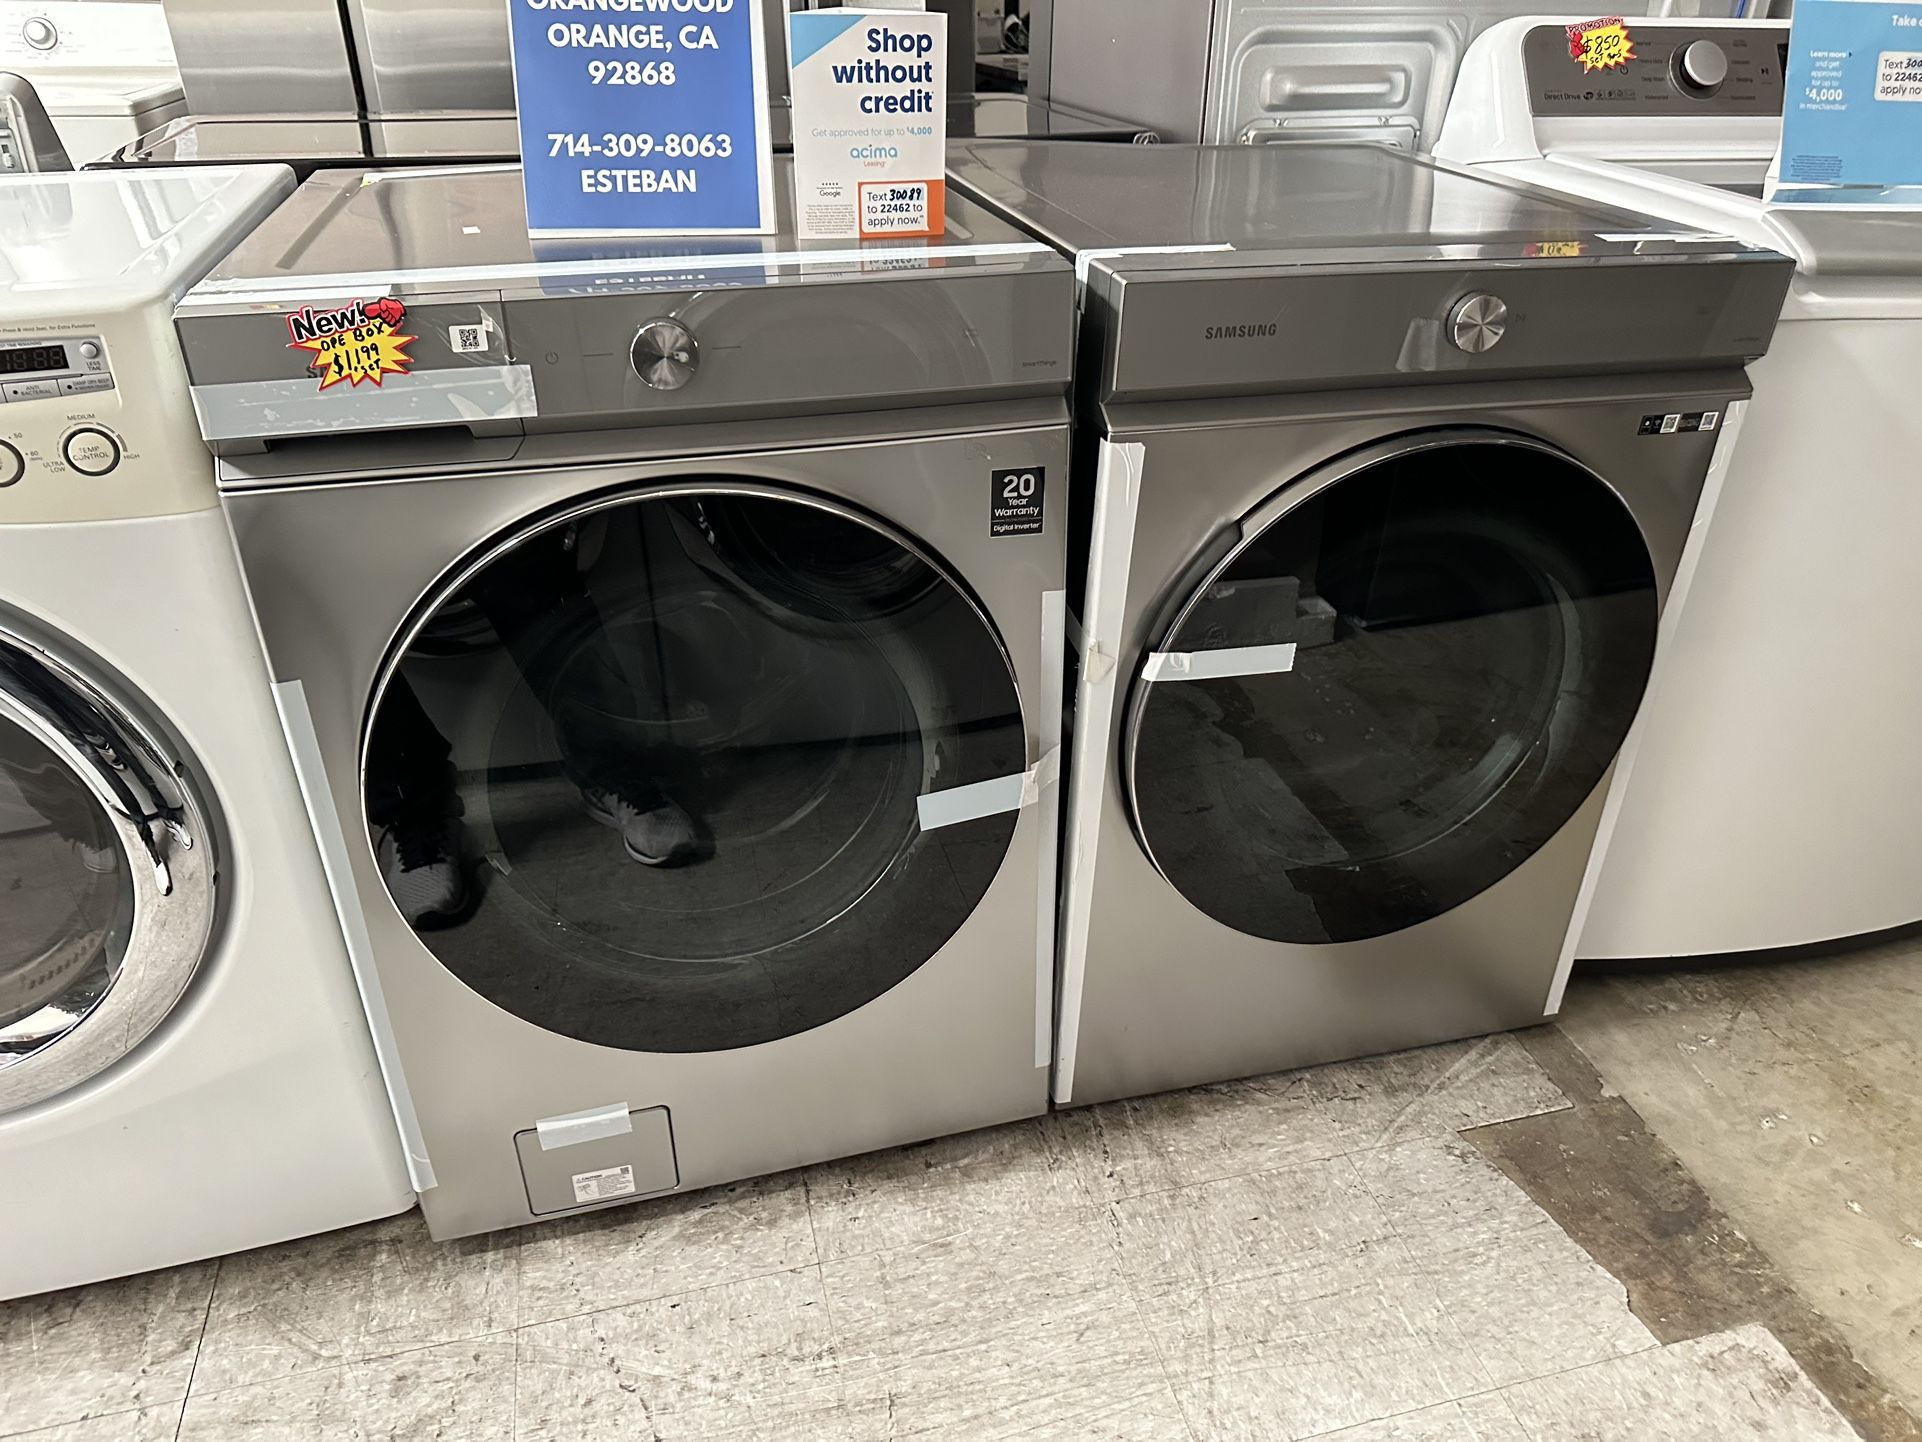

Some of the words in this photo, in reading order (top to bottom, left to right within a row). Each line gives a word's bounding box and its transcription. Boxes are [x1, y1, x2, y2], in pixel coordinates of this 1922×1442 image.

[1892, 14, 1917, 27] Take
[547, 23, 673, 53] ORANGE,
[679, 25, 719, 50] CA
[867, 28, 933, 58] Shop
[1583, 35, 1620, 59] $850
[1810, 50, 1828, 58] Learn
[1828, 61, 1840, 69] get
[1883, 59, 1904, 69] Text
[1904, 58, 1922, 69] 300
[588, 60, 676, 86] 92868
[832, 58, 933, 84] without
[1810, 70, 1842, 78] approved
[1882, 73, 1892, 82] to
[1805, 88, 1843, 102] $4,000
[1880, 84, 1907, 96] apply
[1909, 87, 1922, 95] no
[812, 128, 827, 137] Get
[828, 127, 869, 138] approved
[871, 127, 882, 136] for
[884, 128, 895, 138] up
[896, 127, 905, 136] to
[907, 126, 933, 137] $4,000
[547, 133, 732, 158] 714-309-8063
[849, 144, 898, 159] acima
[581, 169, 697, 193] ESTEBAN
[819, 189, 841, 198] Google
[867, 191, 888, 201] Text
[889, 187, 922, 202] 30089
[867, 205, 878, 214] to
[880, 203, 911, 213] 22462
[913, 203, 923, 213] to
[867, 215, 896, 228] apply
[291, 301, 368, 341] New!
[353, 321, 385, 342] BOX
[1205, 323, 1278, 340] SAMSUNG
[66, 413, 96, 421] MEDIUM
[72, 451, 110, 461] CONTROL
[78, 445, 100, 454] TEMP
[1003, 473, 1035, 498] 20
[1007, 497, 1029, 506] Year
[994, 506, 1040, 517] Warranty
[993, 524, 1014, 532] Digital
[1014, 522, 1040, 531] Inverter
